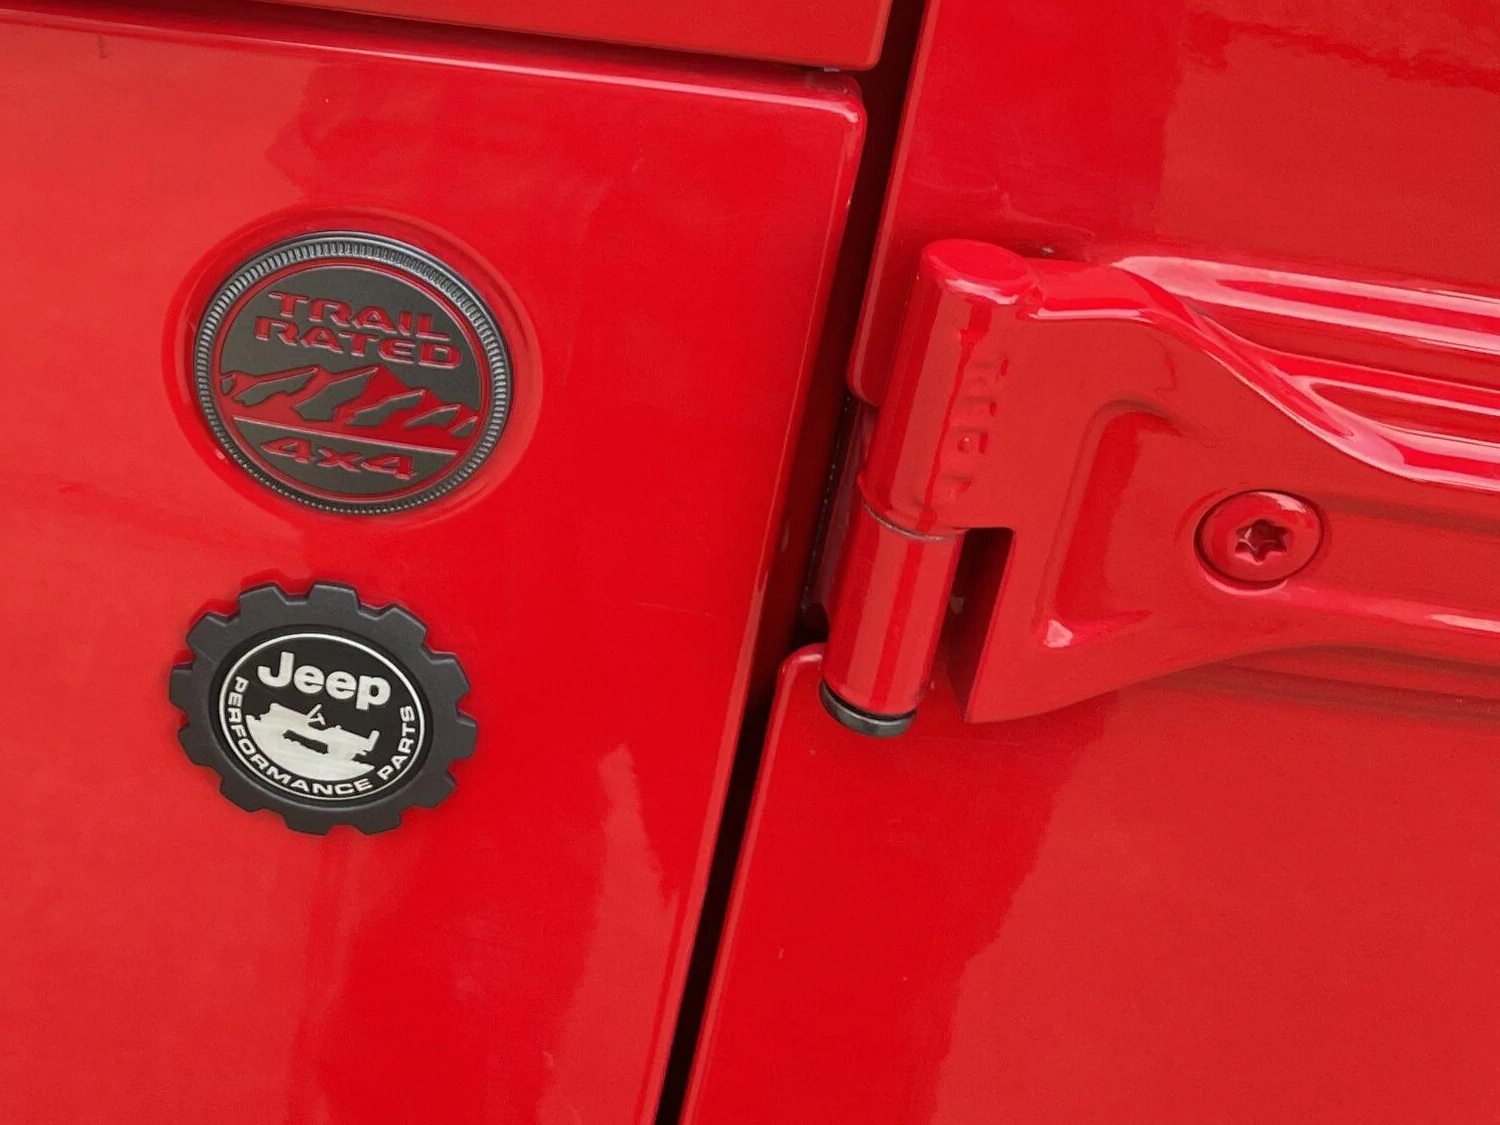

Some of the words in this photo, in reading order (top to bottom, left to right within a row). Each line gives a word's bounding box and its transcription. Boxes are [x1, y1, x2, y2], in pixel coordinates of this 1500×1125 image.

[254, 315, 462, 370] RATED
[268, 290, 450, 342] TRAIL
[257, 651, 392, 711] Jeep
[226, 676, 372, 796] PERFORMANCE
[377, 705, 416, 780] PARTS
